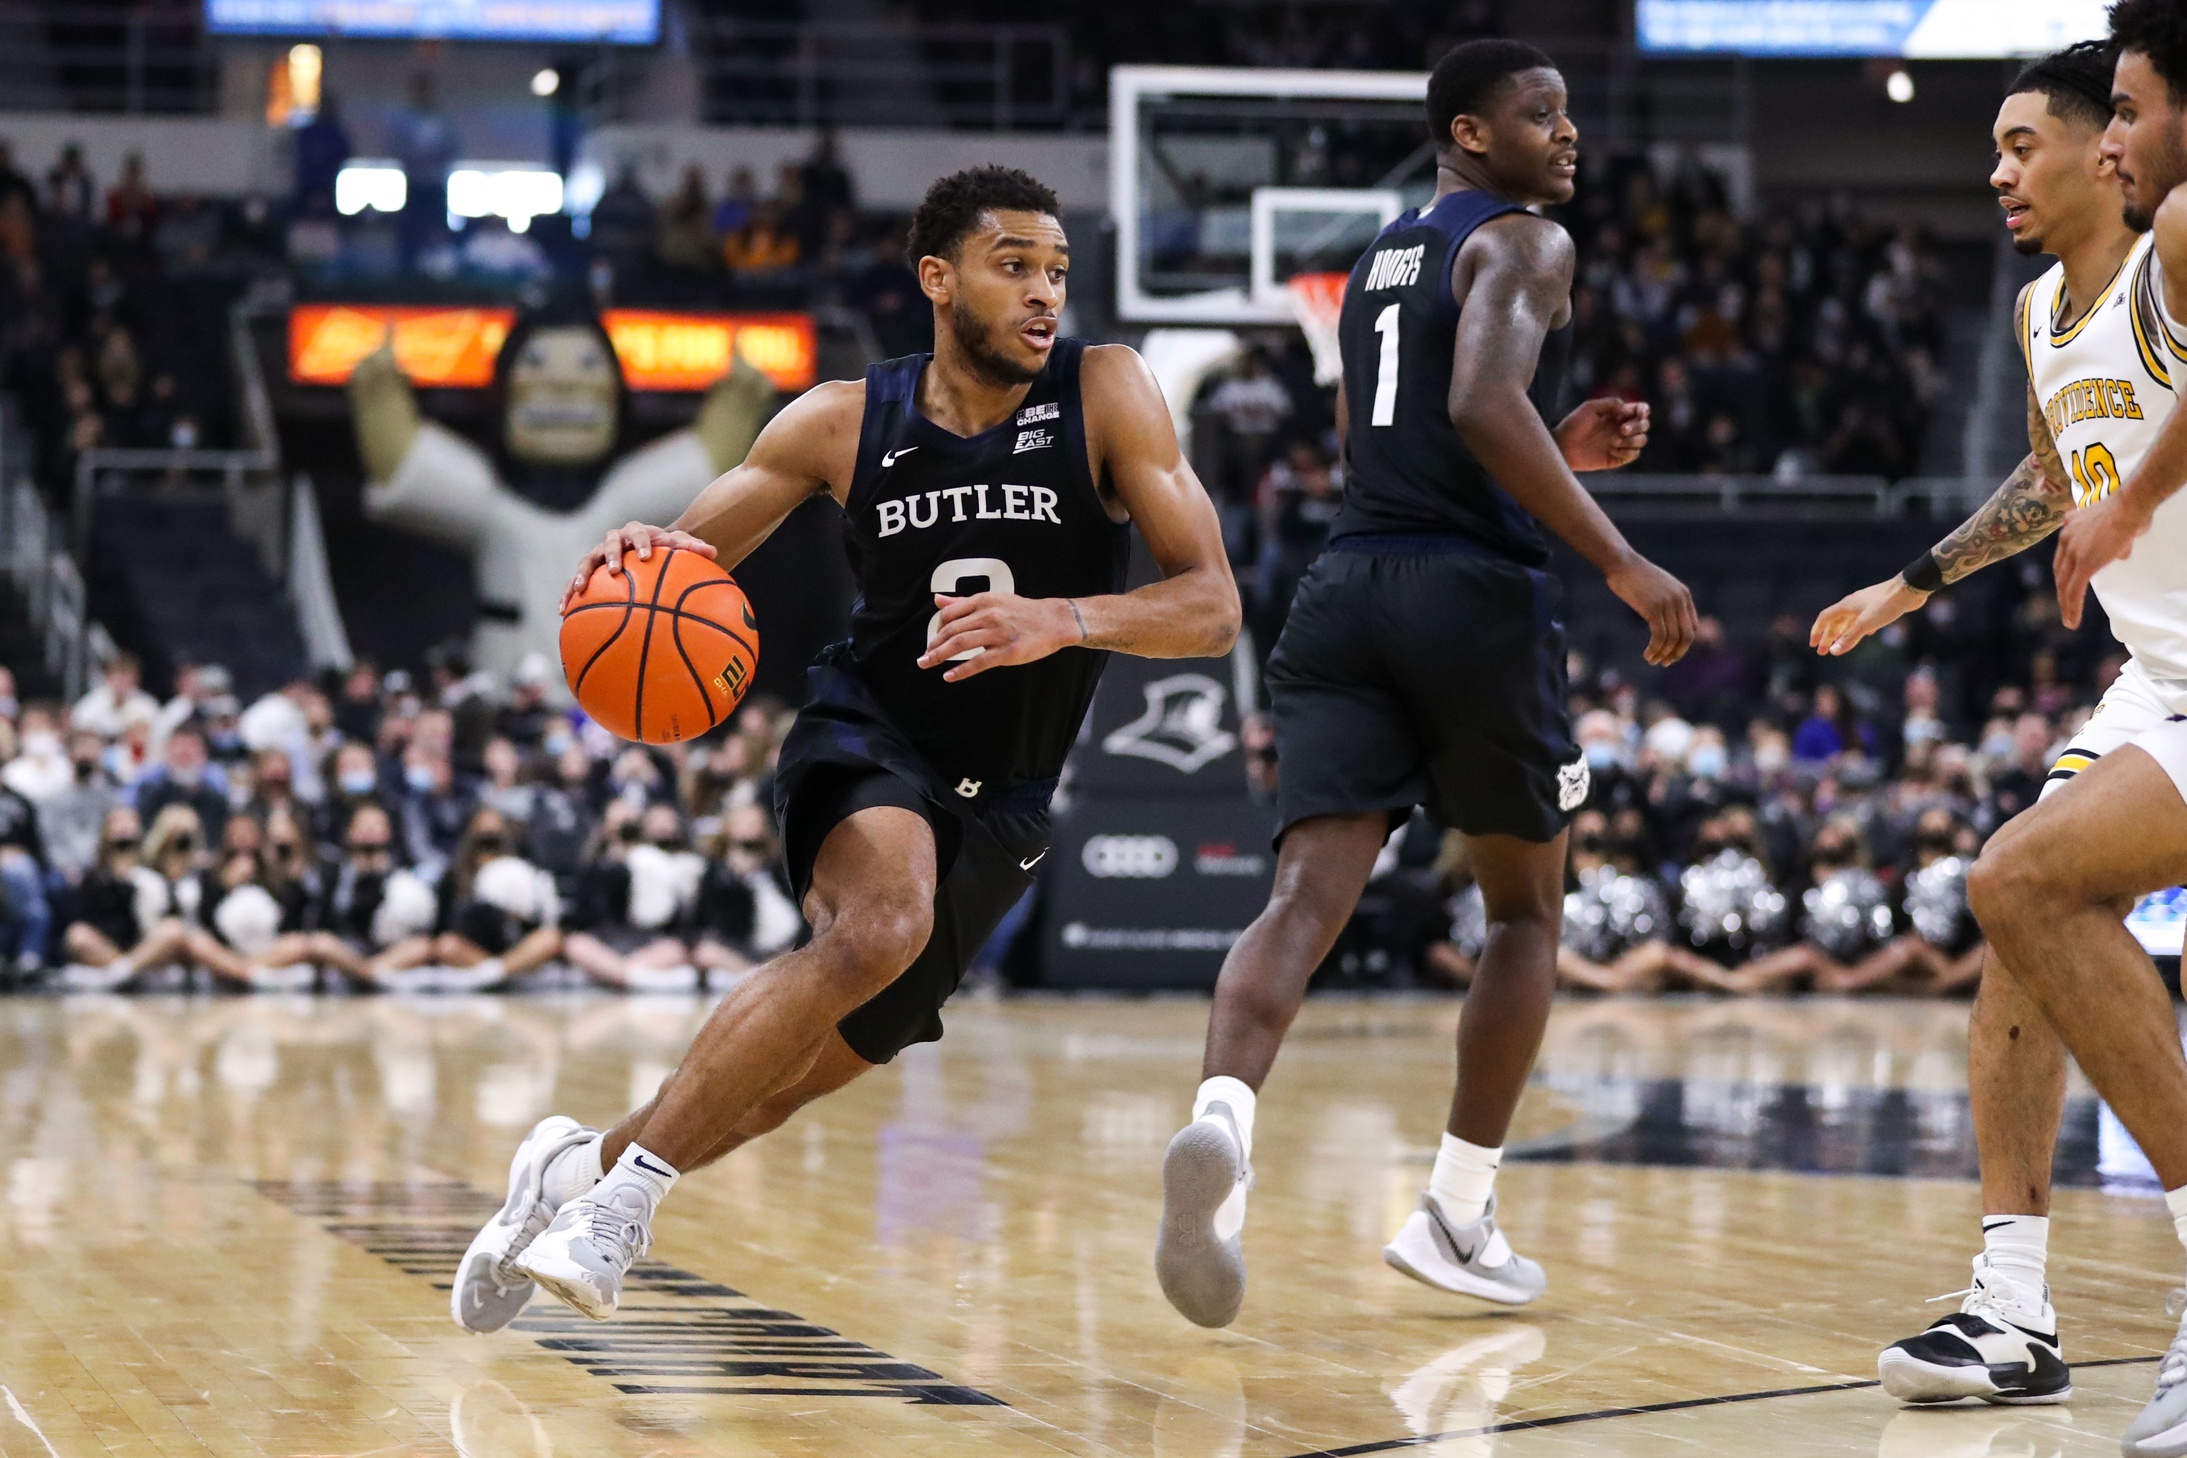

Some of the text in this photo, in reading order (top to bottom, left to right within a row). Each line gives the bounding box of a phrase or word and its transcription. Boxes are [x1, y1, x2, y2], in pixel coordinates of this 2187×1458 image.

[1365, 244, 1425, 291] HODGES
[1372, 303, 1400, 426] 1
[1016, 411, 1060, 426] CHANGE
[1014, 436, 1054, 450] EAST
[1018, 429, 1045, 441] BIG
[876, 484, 1061, 538] BUTLER
